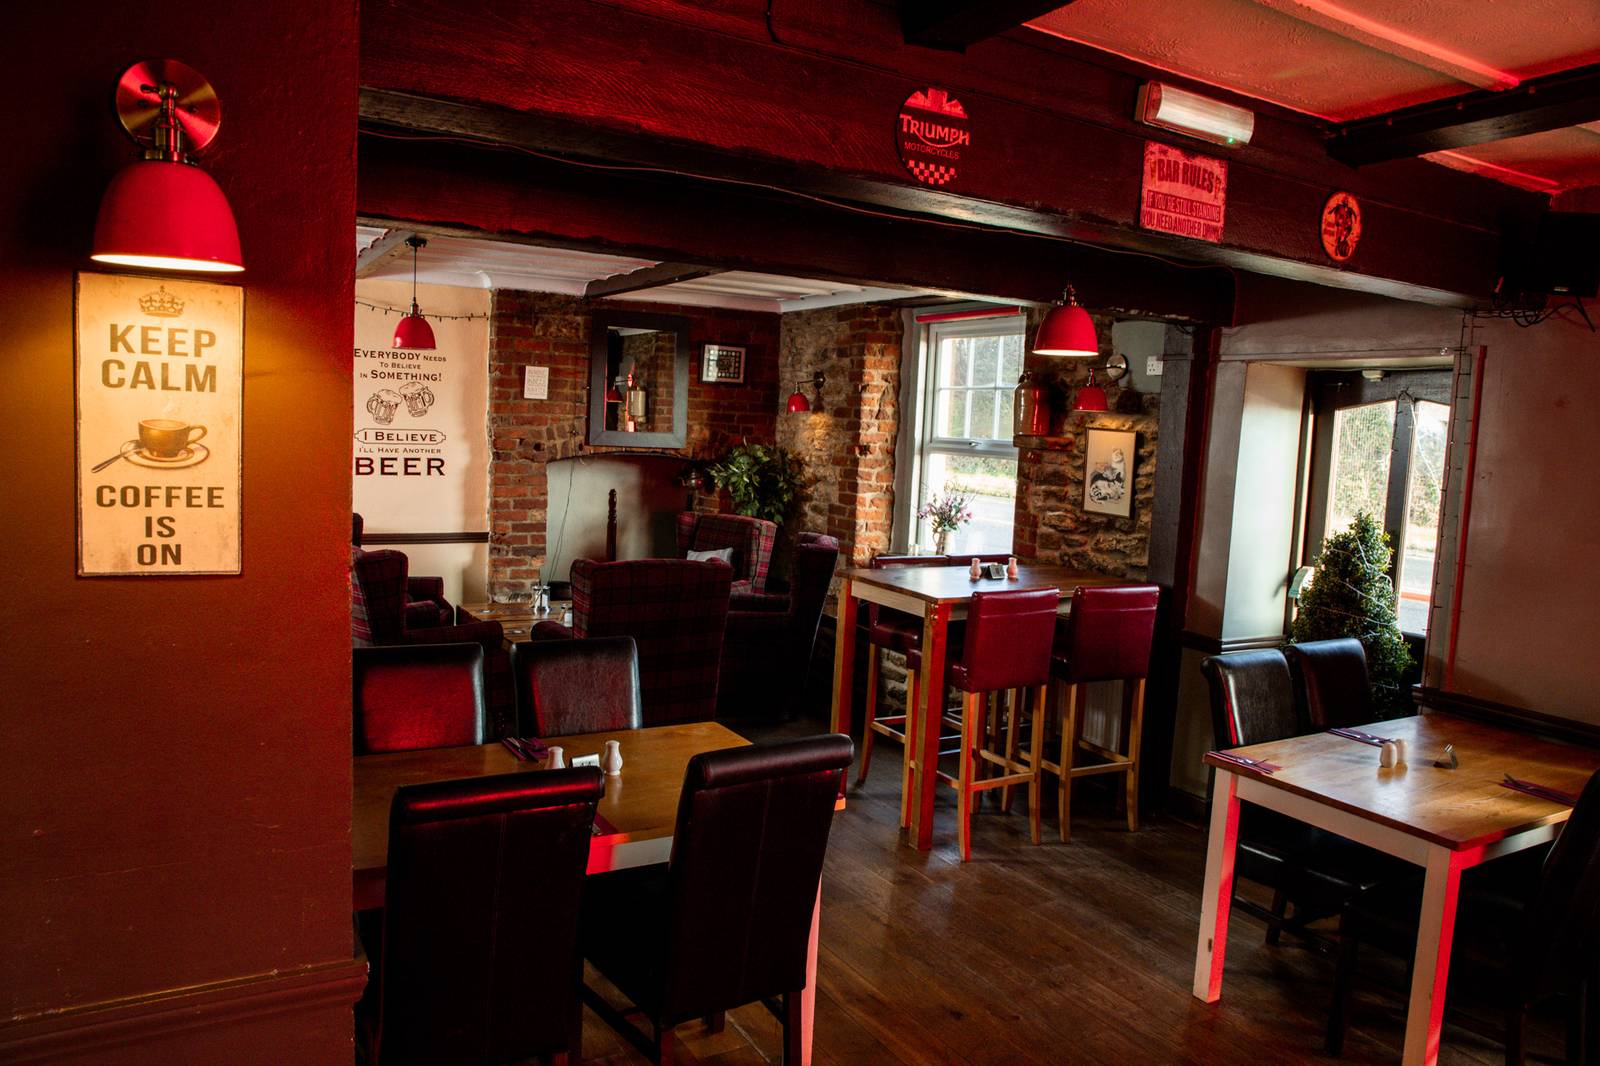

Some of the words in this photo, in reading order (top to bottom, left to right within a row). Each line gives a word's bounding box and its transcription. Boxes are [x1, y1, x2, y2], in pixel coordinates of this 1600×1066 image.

[900, 113, 970, 146] TRIUMPH
[904, 141, 960, 160] MOTORCYCLES
[1157, 158, 1180, 183] BAR
[1182, 162, 1214, 193] RULES
[1147, 191, 1154, 208] IF
[1175, 198, 1192, 216] STILL
[1192, 202, 1220, 222] STANDING
[1141, 210, 1155, 227] YOU
[1156, 213, 1173, 231] NEED
[1173, 216, 1201, 236] ANOTHER
[109, 323, 217, 358] KEEP
[354, 348, 421, 361] EVERYBODY
[380, 361, 389, 369] TO
[391, 362, 421, 370] BELIEVE
[101, 358, 217, 393] CALM
[370, 369, 442, 382] SOMETHING!
[364, 431, 368, 441] I
[375, 431, 437, 442] BELIEVE
[359, 446, 374, 454] I'LL
[355, 456, 446, 477] BEER
[96, 484, 225, 509] COFFEE
[145, 516, 176, 538] IS
[137, 543, 182, 566] ON
